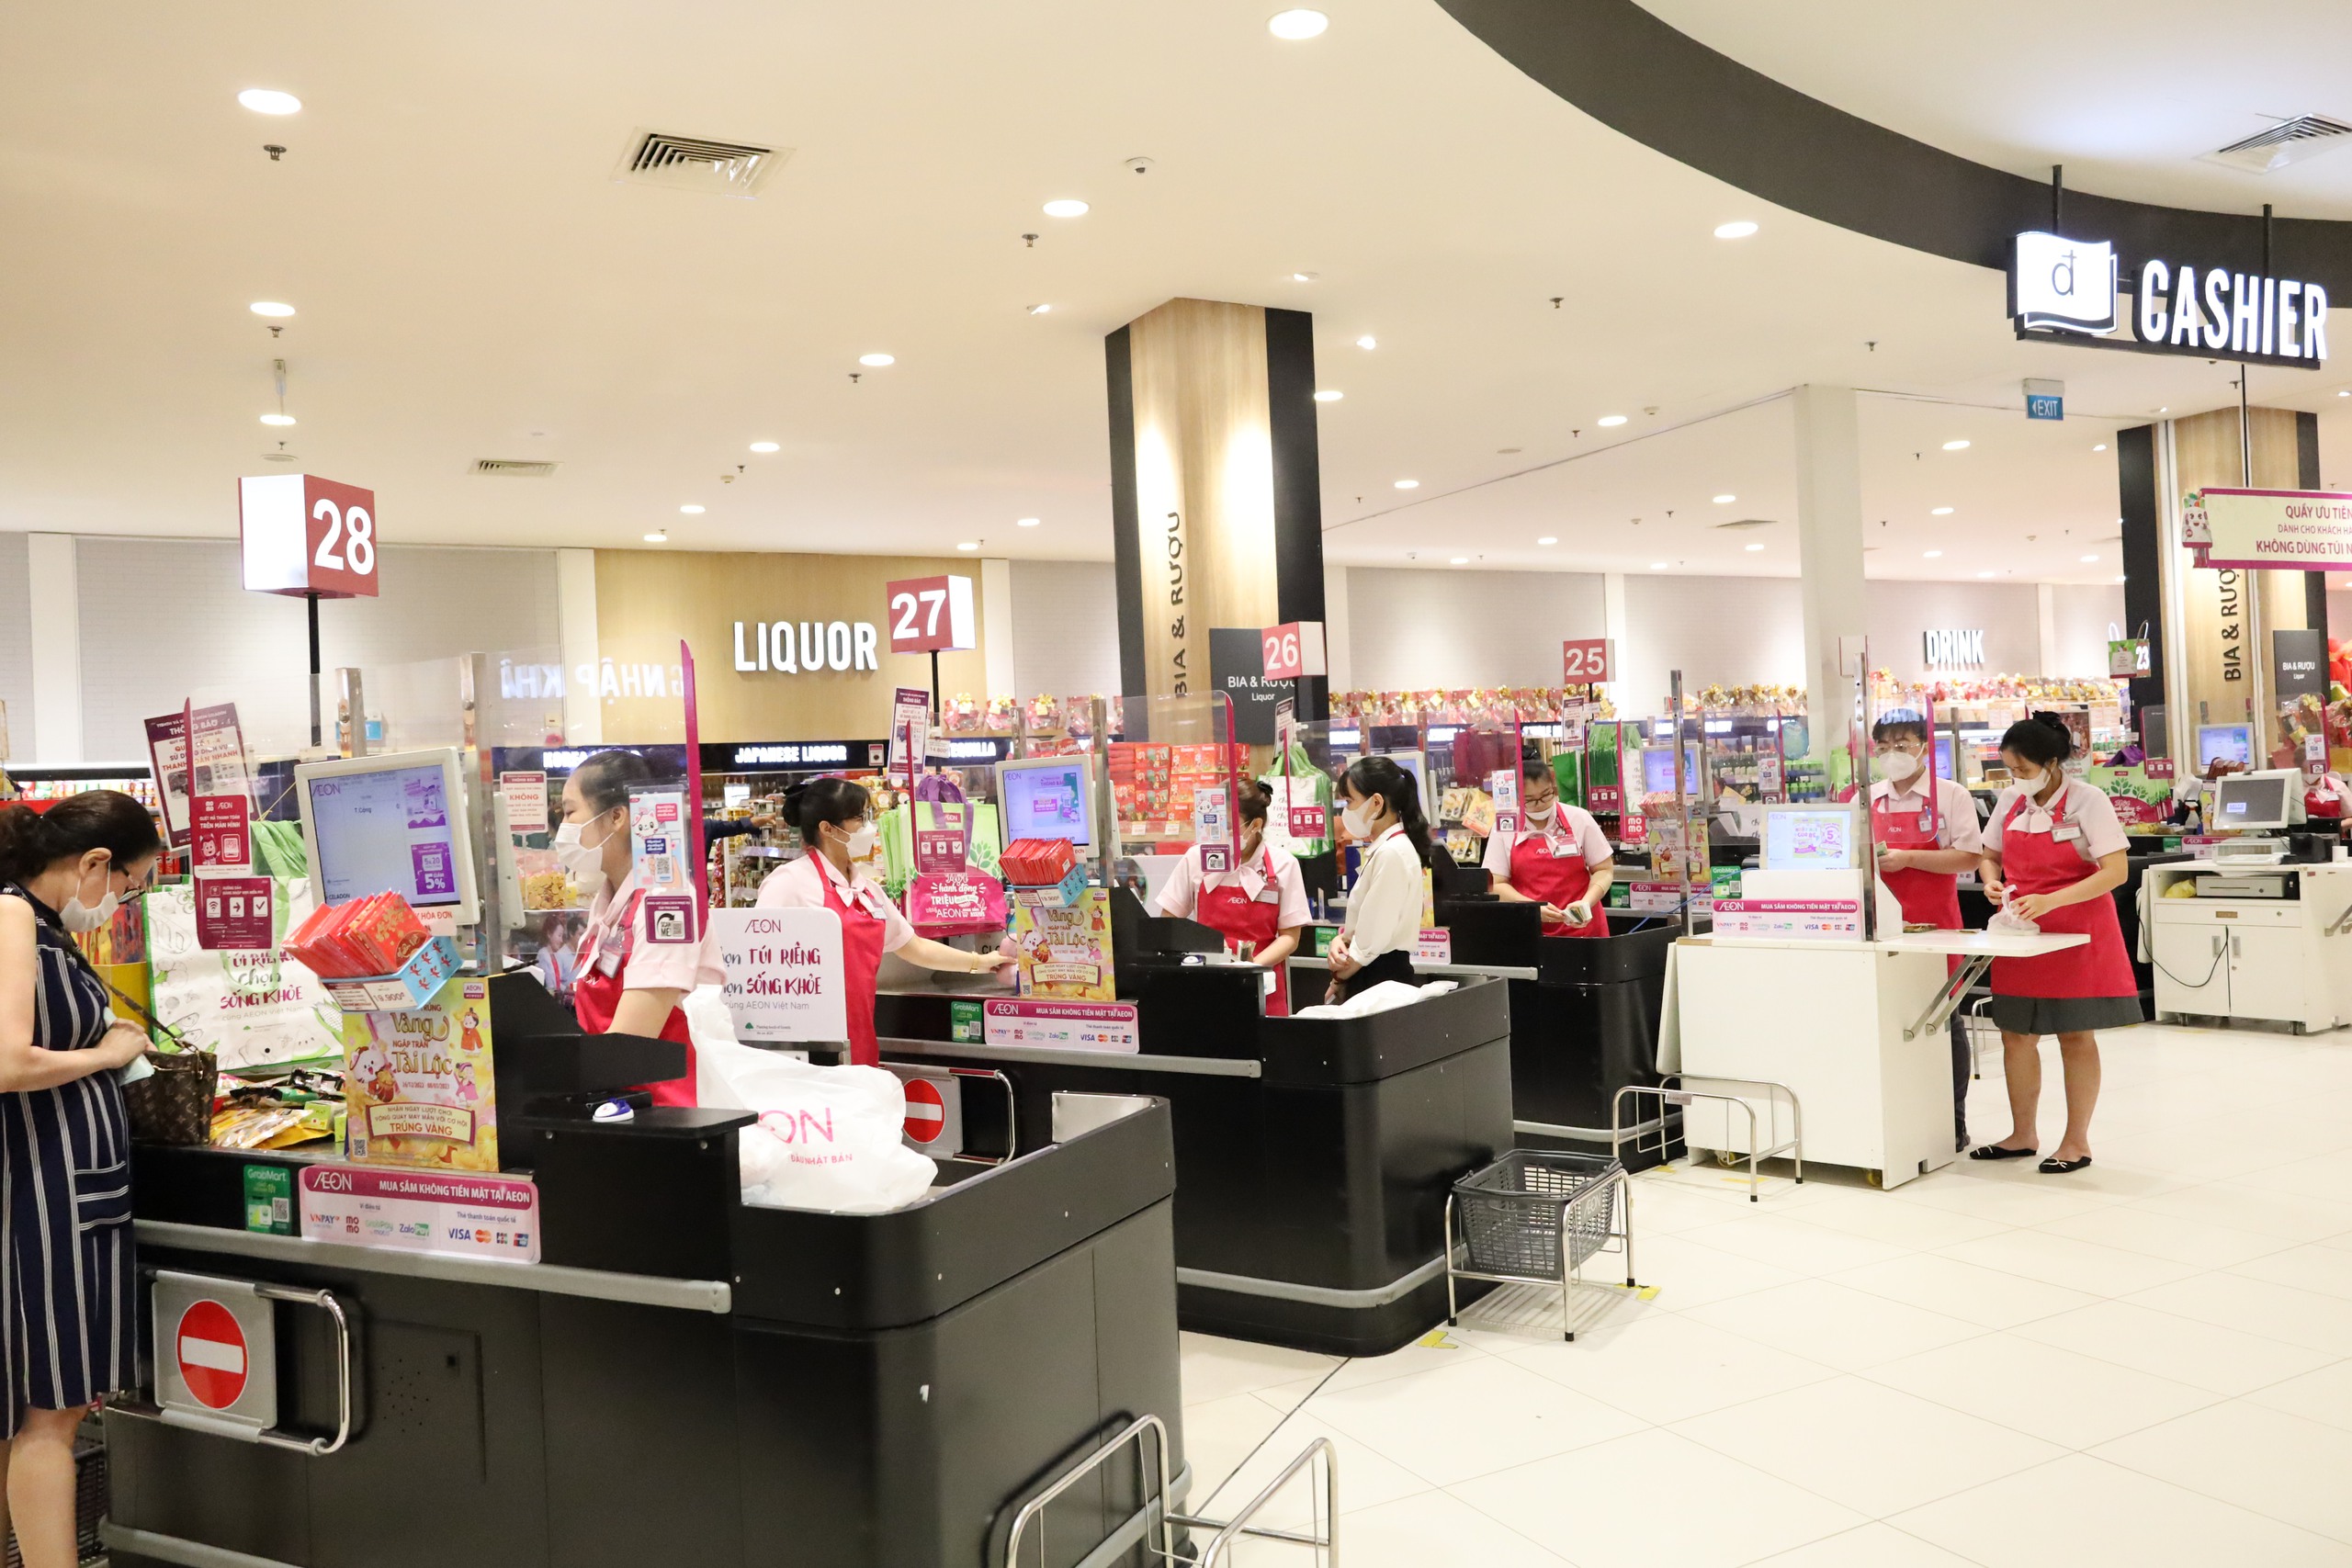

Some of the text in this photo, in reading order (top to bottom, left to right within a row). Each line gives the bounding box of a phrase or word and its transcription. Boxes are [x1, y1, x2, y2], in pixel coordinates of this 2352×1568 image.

[2140, 260, 2327, 360] CASHIER
[2038, 399, 2058, 417] EXIT
[2316, 505, 2330, 519] ƯU
[312, 498, 375, 576] 28
[2278, 523, 2342, 535] DÀNH CHO KHÁCH
[2256, 538, 2295, 553] KHÔNG
[2297, 539, 2325, 554] DÙNG
[2327, 540, 2344, 555] TÚI
[1168, 512, 1187, 698] BIA & RƯỢU
[891, 589, 946, 641] 27
[2219, 569, 2242, 682] BIA & RƯỢ
[733, 620, 878, 674] LIQUOR
[1265, 633, 1298, 671] 26
[1925, 629, 1984, 664] DRINK
[1566, 647, 1605, 676] 25
[2135, 645, 2150, 670] 23
[2282, 661, 2293, 671] BIA
[1227, 676, 1258, 688] BIA &
[1251, 693, 1275, 702] Liquor
[169, 722, 198, 736] THÔG
[735, 745, 847, 763] JAPANESE LIQUOR
[424, 873, 446, 889] 5%
[936, 908, 962, 918] AEON
[1773, 902, 1786, 910] SẮM
[749, 941, 820, 968] TÚI RIÊNG
[238, 968, 282, 987] chọn
[746, 971, 822, 997] SỐNG KHỎE
[220, 985, 303, 1010] SỐNG KHỎE
[746, 1000, 771, 1009] AEON
[773, 999, 788, 1010] Việt
[790, 1001, 809, 1010] Nam
[243, 1010, 267, 1018] AEON
[953, 1003, 979, 1012] GrabMart
[1035, 1007, 1048, 1015] MUA
[1048, 1006, 1061, 1015] SẮM
[1061, 1007, 1082, 1017] KHÔNG
[1081, 1008, 1094, 1017] TIỀN
[1094, 1010, 1107, 1019] MẶT
[1080, 1033, 1095, 1042] VISA
[422, 1052, 453, 1079] Lộc
[390, 1120, 453, 1135] TRÚNG VÀNG
[758, 1107, 833, 1144] ON
[804, 1154, 828, 1167] NHẬT
[247, 1168, 287, 1181] GrabMart
[379, 1180, 398, 1192] MUA
[399, 1179, 418, 1193] SẮM
[419, 1182, 449, 1197] KHÔNG
[450, 1183, 469, 1198] TIỀN
[470, 1189, 489, 1202] MẶT
[491, 1189, 504, 1203] TẠI
[505, 1190, 530, 1203] AEON
[310, 1213, 335, 1224] VNPAY
[483, 1213, 496, 1222] toán
[496, 1213, 510, 1224] quốc
[510, 1214, 516, 1224] tế
[448, 1228, 471, 1241] VISA
